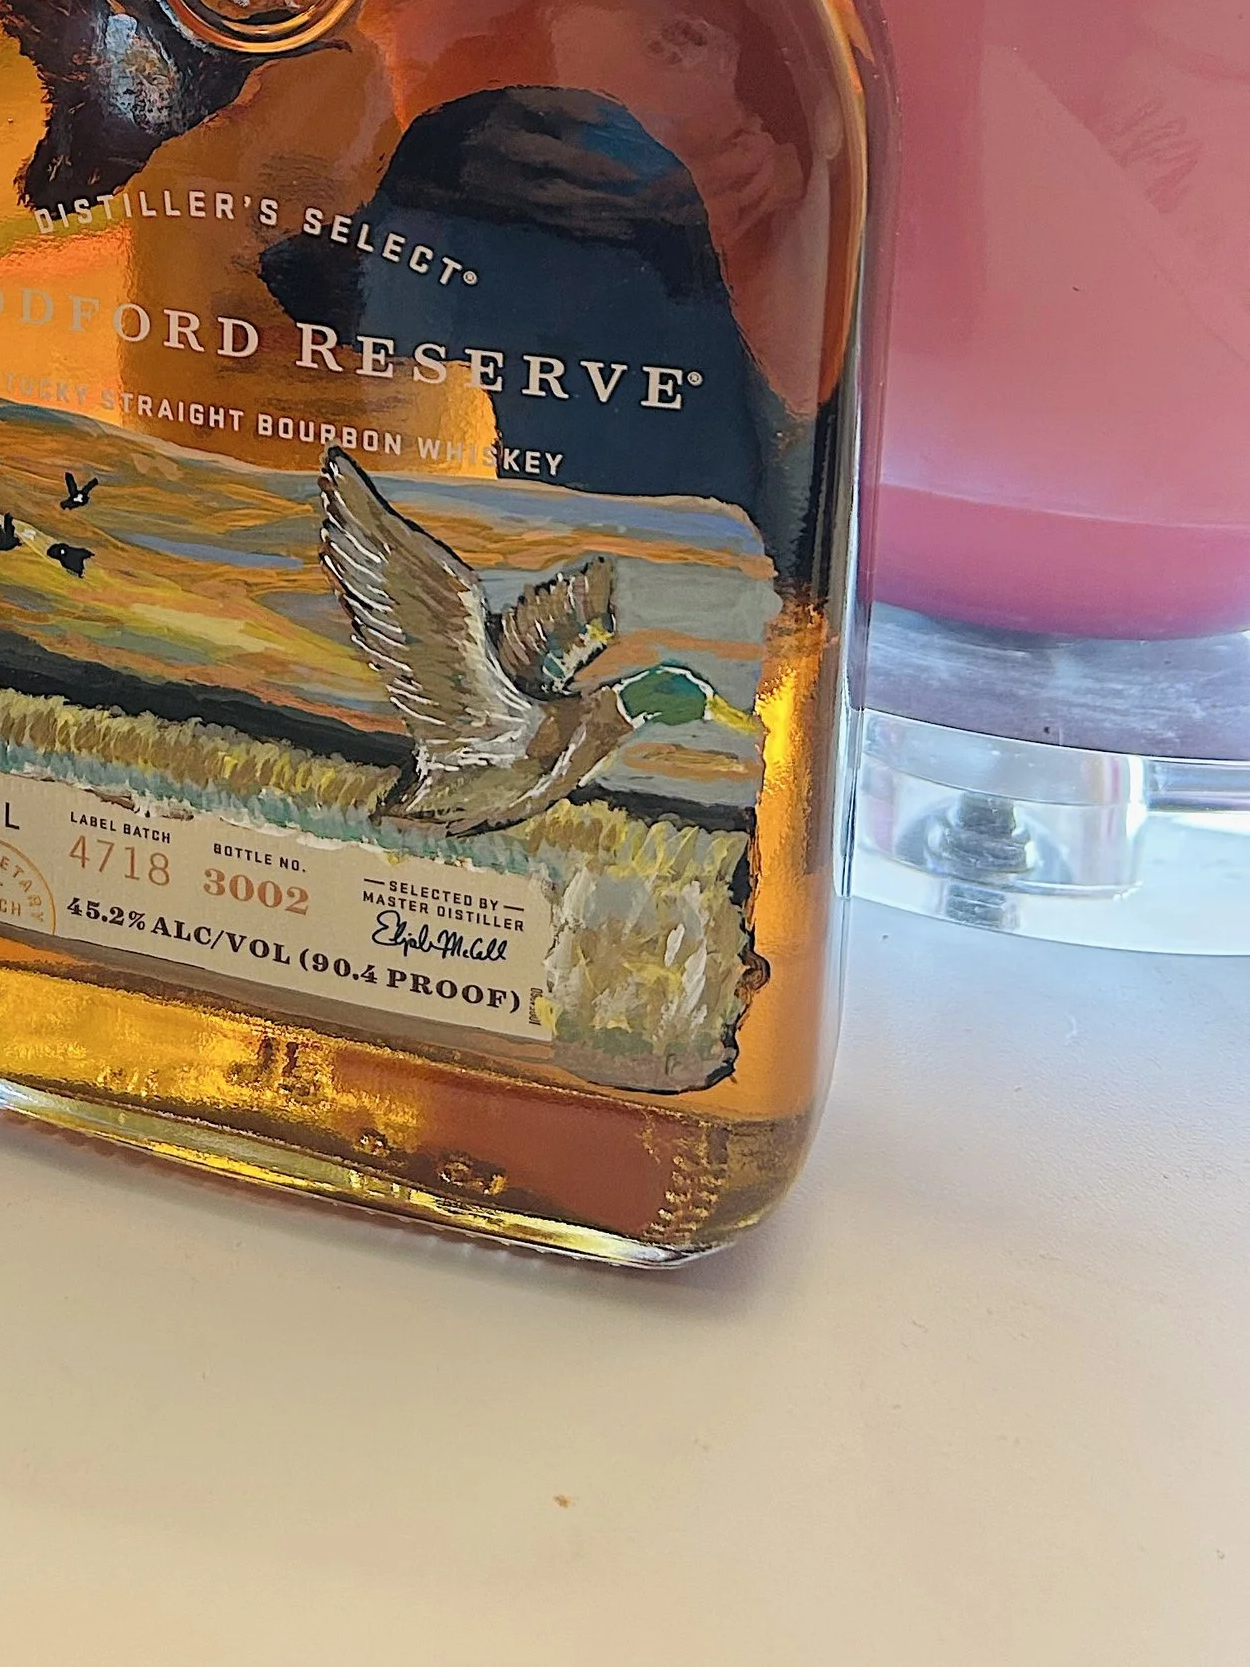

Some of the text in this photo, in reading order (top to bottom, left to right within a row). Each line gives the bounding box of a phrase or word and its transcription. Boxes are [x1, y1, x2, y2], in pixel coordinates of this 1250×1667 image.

[35, 190, 279, 234] DISTILLER'S
[101, 387, 244, 433] STRAIGHT
[258, 413, 402, 457] BOURBON
[417, 436, 564, 477] WHISKEY
[70, 810, 172, 845] LABEL BATCH
[68, 835, 171, 887] 4718
[213, 842, 307, 874] BOTTLE NO.
[203, 867, 311, 917] 3002
[362, 890, 525, 933] MASTER DISTILLER
[388, 879, 500, 912] SELECTED BY
[67, 896, 147, 931] 45.2%
[151, 916, 292, 966] ALC/VOL
[298, 947, 379, 985] (90.4
[386, 967, 521, 1014] PROOF)
